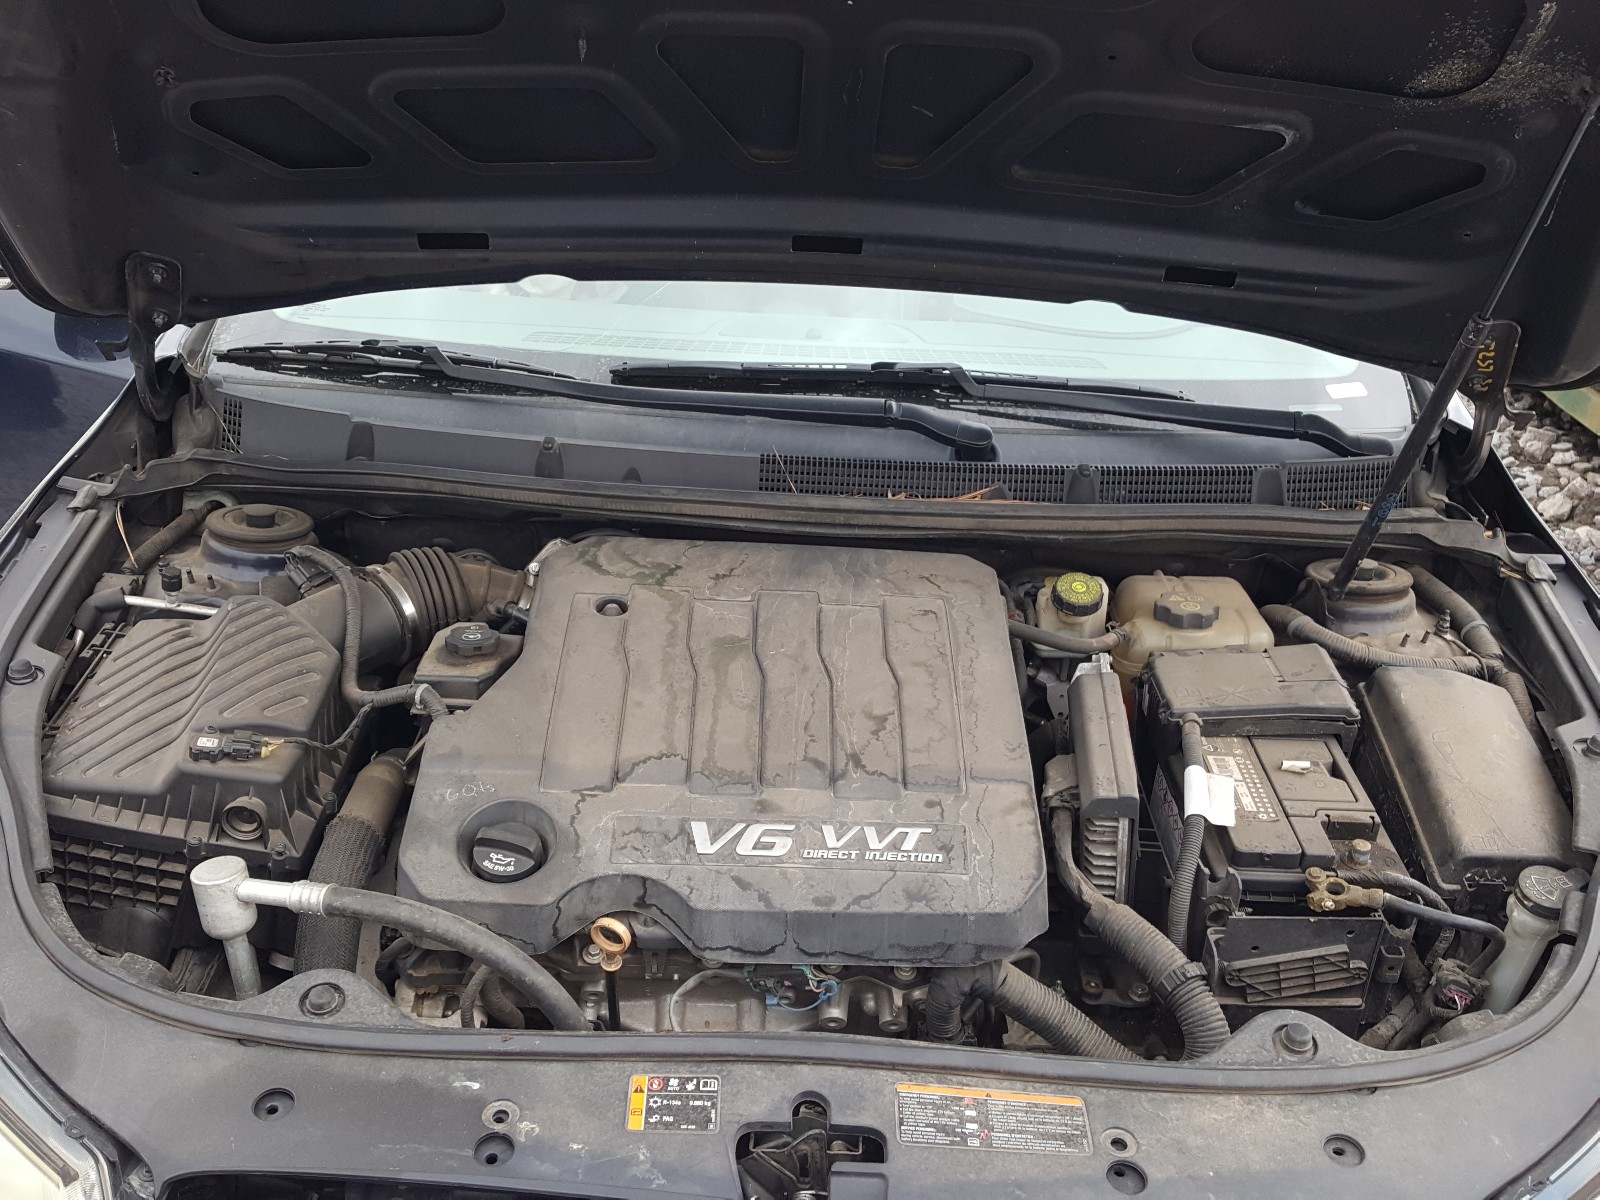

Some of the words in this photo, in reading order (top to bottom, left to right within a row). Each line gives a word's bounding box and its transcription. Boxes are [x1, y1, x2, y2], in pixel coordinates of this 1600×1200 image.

[690, 821, 796, 857] V6
[821, 824, 933, 851] VVT
[802, 848, 860, 860] DIRECT
[864, 850, 943, 863] INJECTION
[482, 860, 495, 870] SAE
